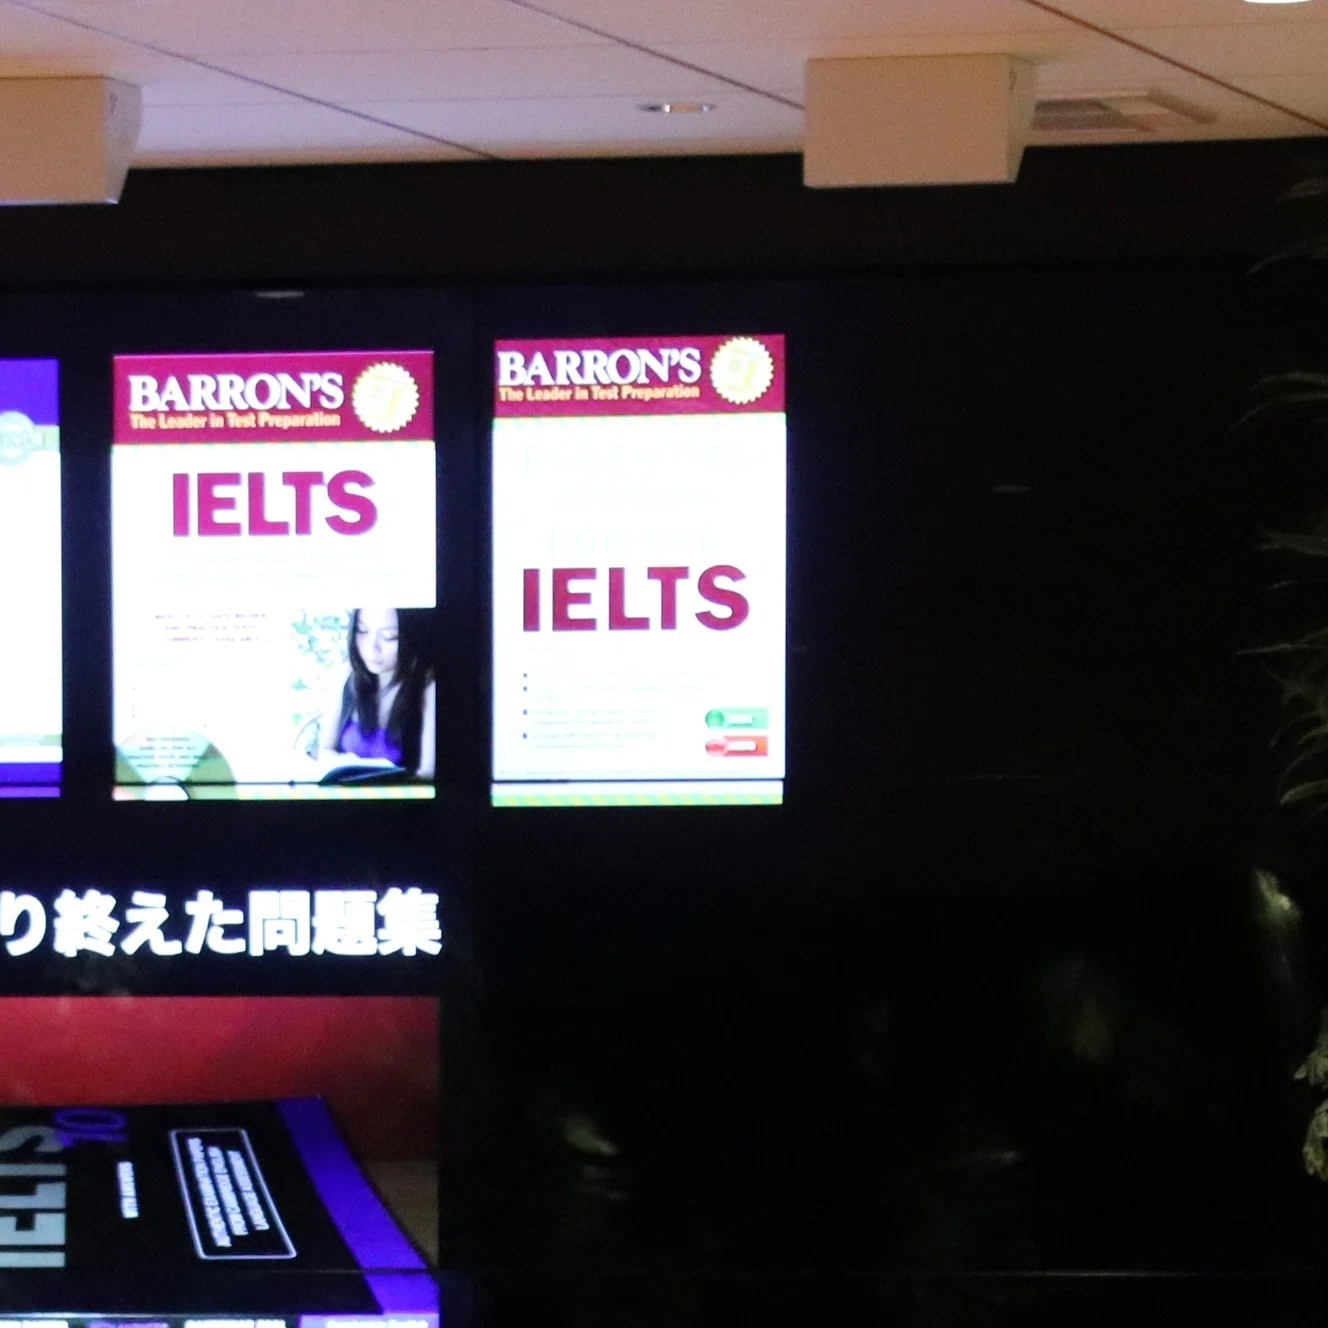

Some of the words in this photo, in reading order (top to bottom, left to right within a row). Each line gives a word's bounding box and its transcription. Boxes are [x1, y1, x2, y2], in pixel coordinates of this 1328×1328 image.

[497, 348, 702, 387] BARRON'S
[128, 372, 345, 412] BARRON'S
[498, 386, 524, 402] The
[526, 385, 573, 401] Leader
[575, 385, 589, 401] in
[590, 384, 620, 400] Test
[621, 383, 701, 401] Preparation
[129, 413, 156, 430] The
[158, 412, 208, 430] Leader
[209, 412, 224, 428] in
[225, 412, 257, 428] Test
[258, 411, 342, 430] Preparation
[172, 470, 379, 537] IELTS
[522, 564, 751, 633] IELTS
